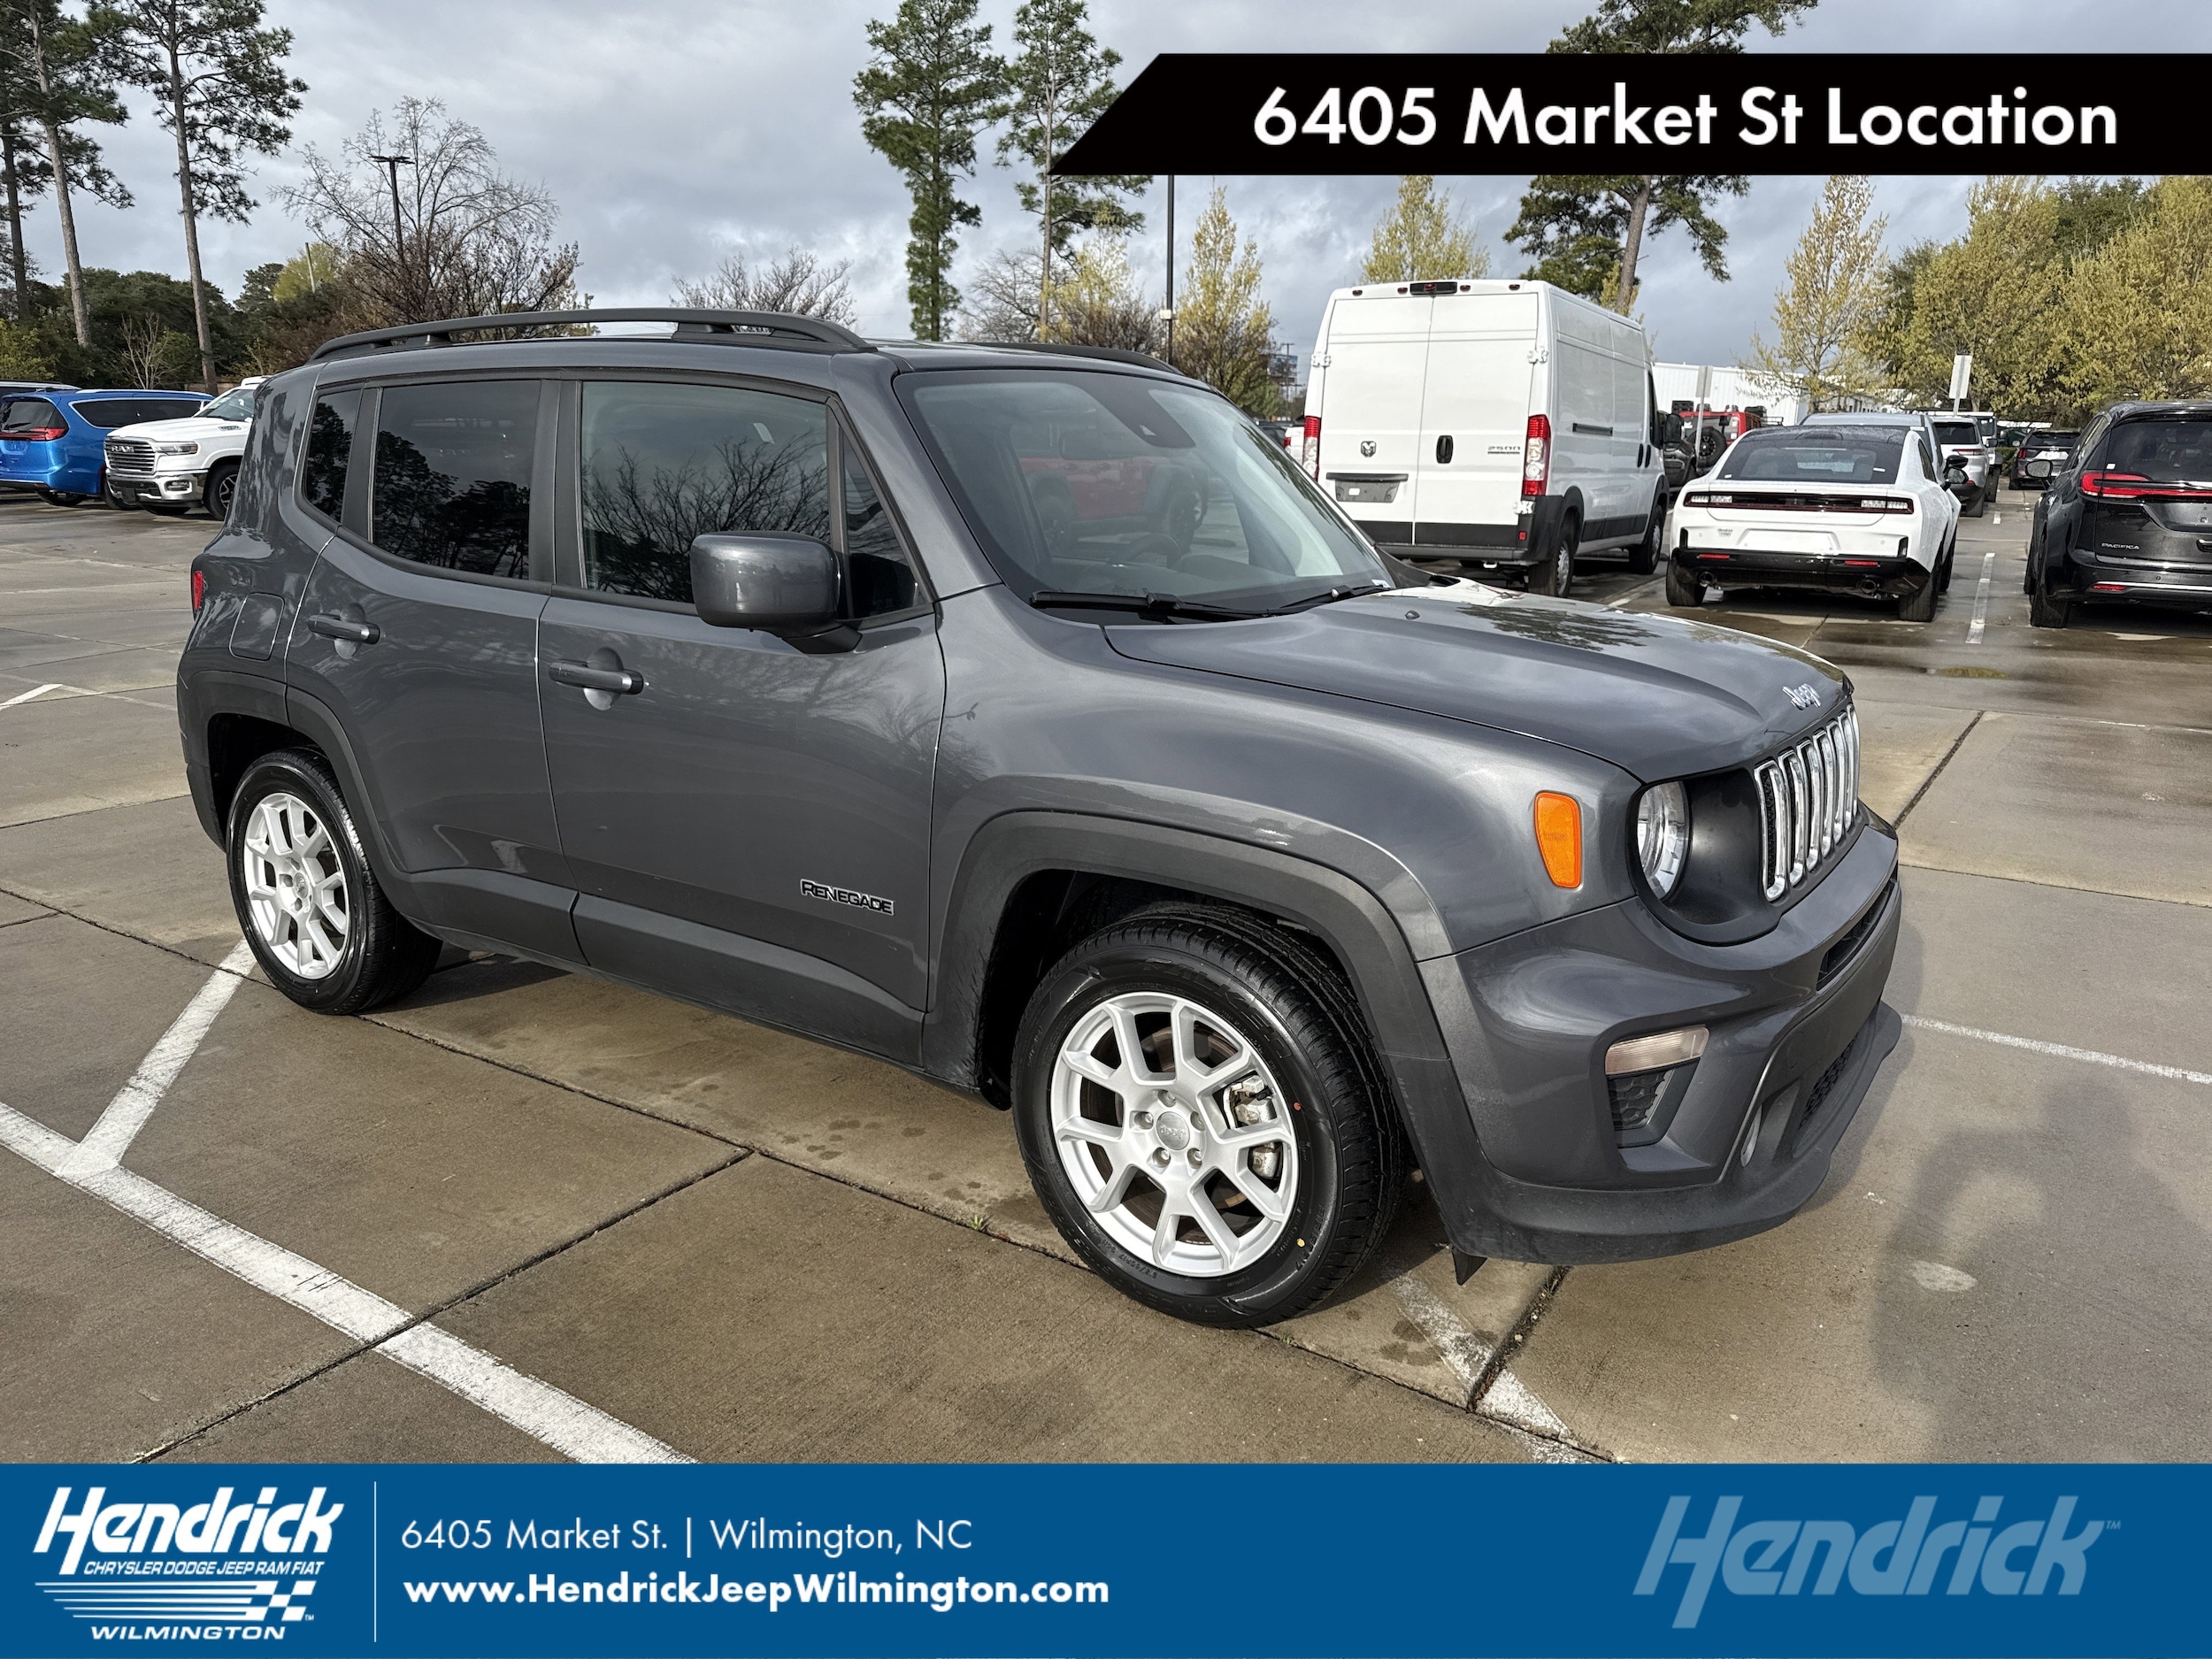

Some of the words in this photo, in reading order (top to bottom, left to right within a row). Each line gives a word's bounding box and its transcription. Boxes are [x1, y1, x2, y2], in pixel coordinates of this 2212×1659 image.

[111, 444, 134, 453] RAM
[1782, 683, 1822, 710] Jeep
[800, 879, 895, 917] RENEGADE
[1159, 1125, 1186, 1140] Jeep
